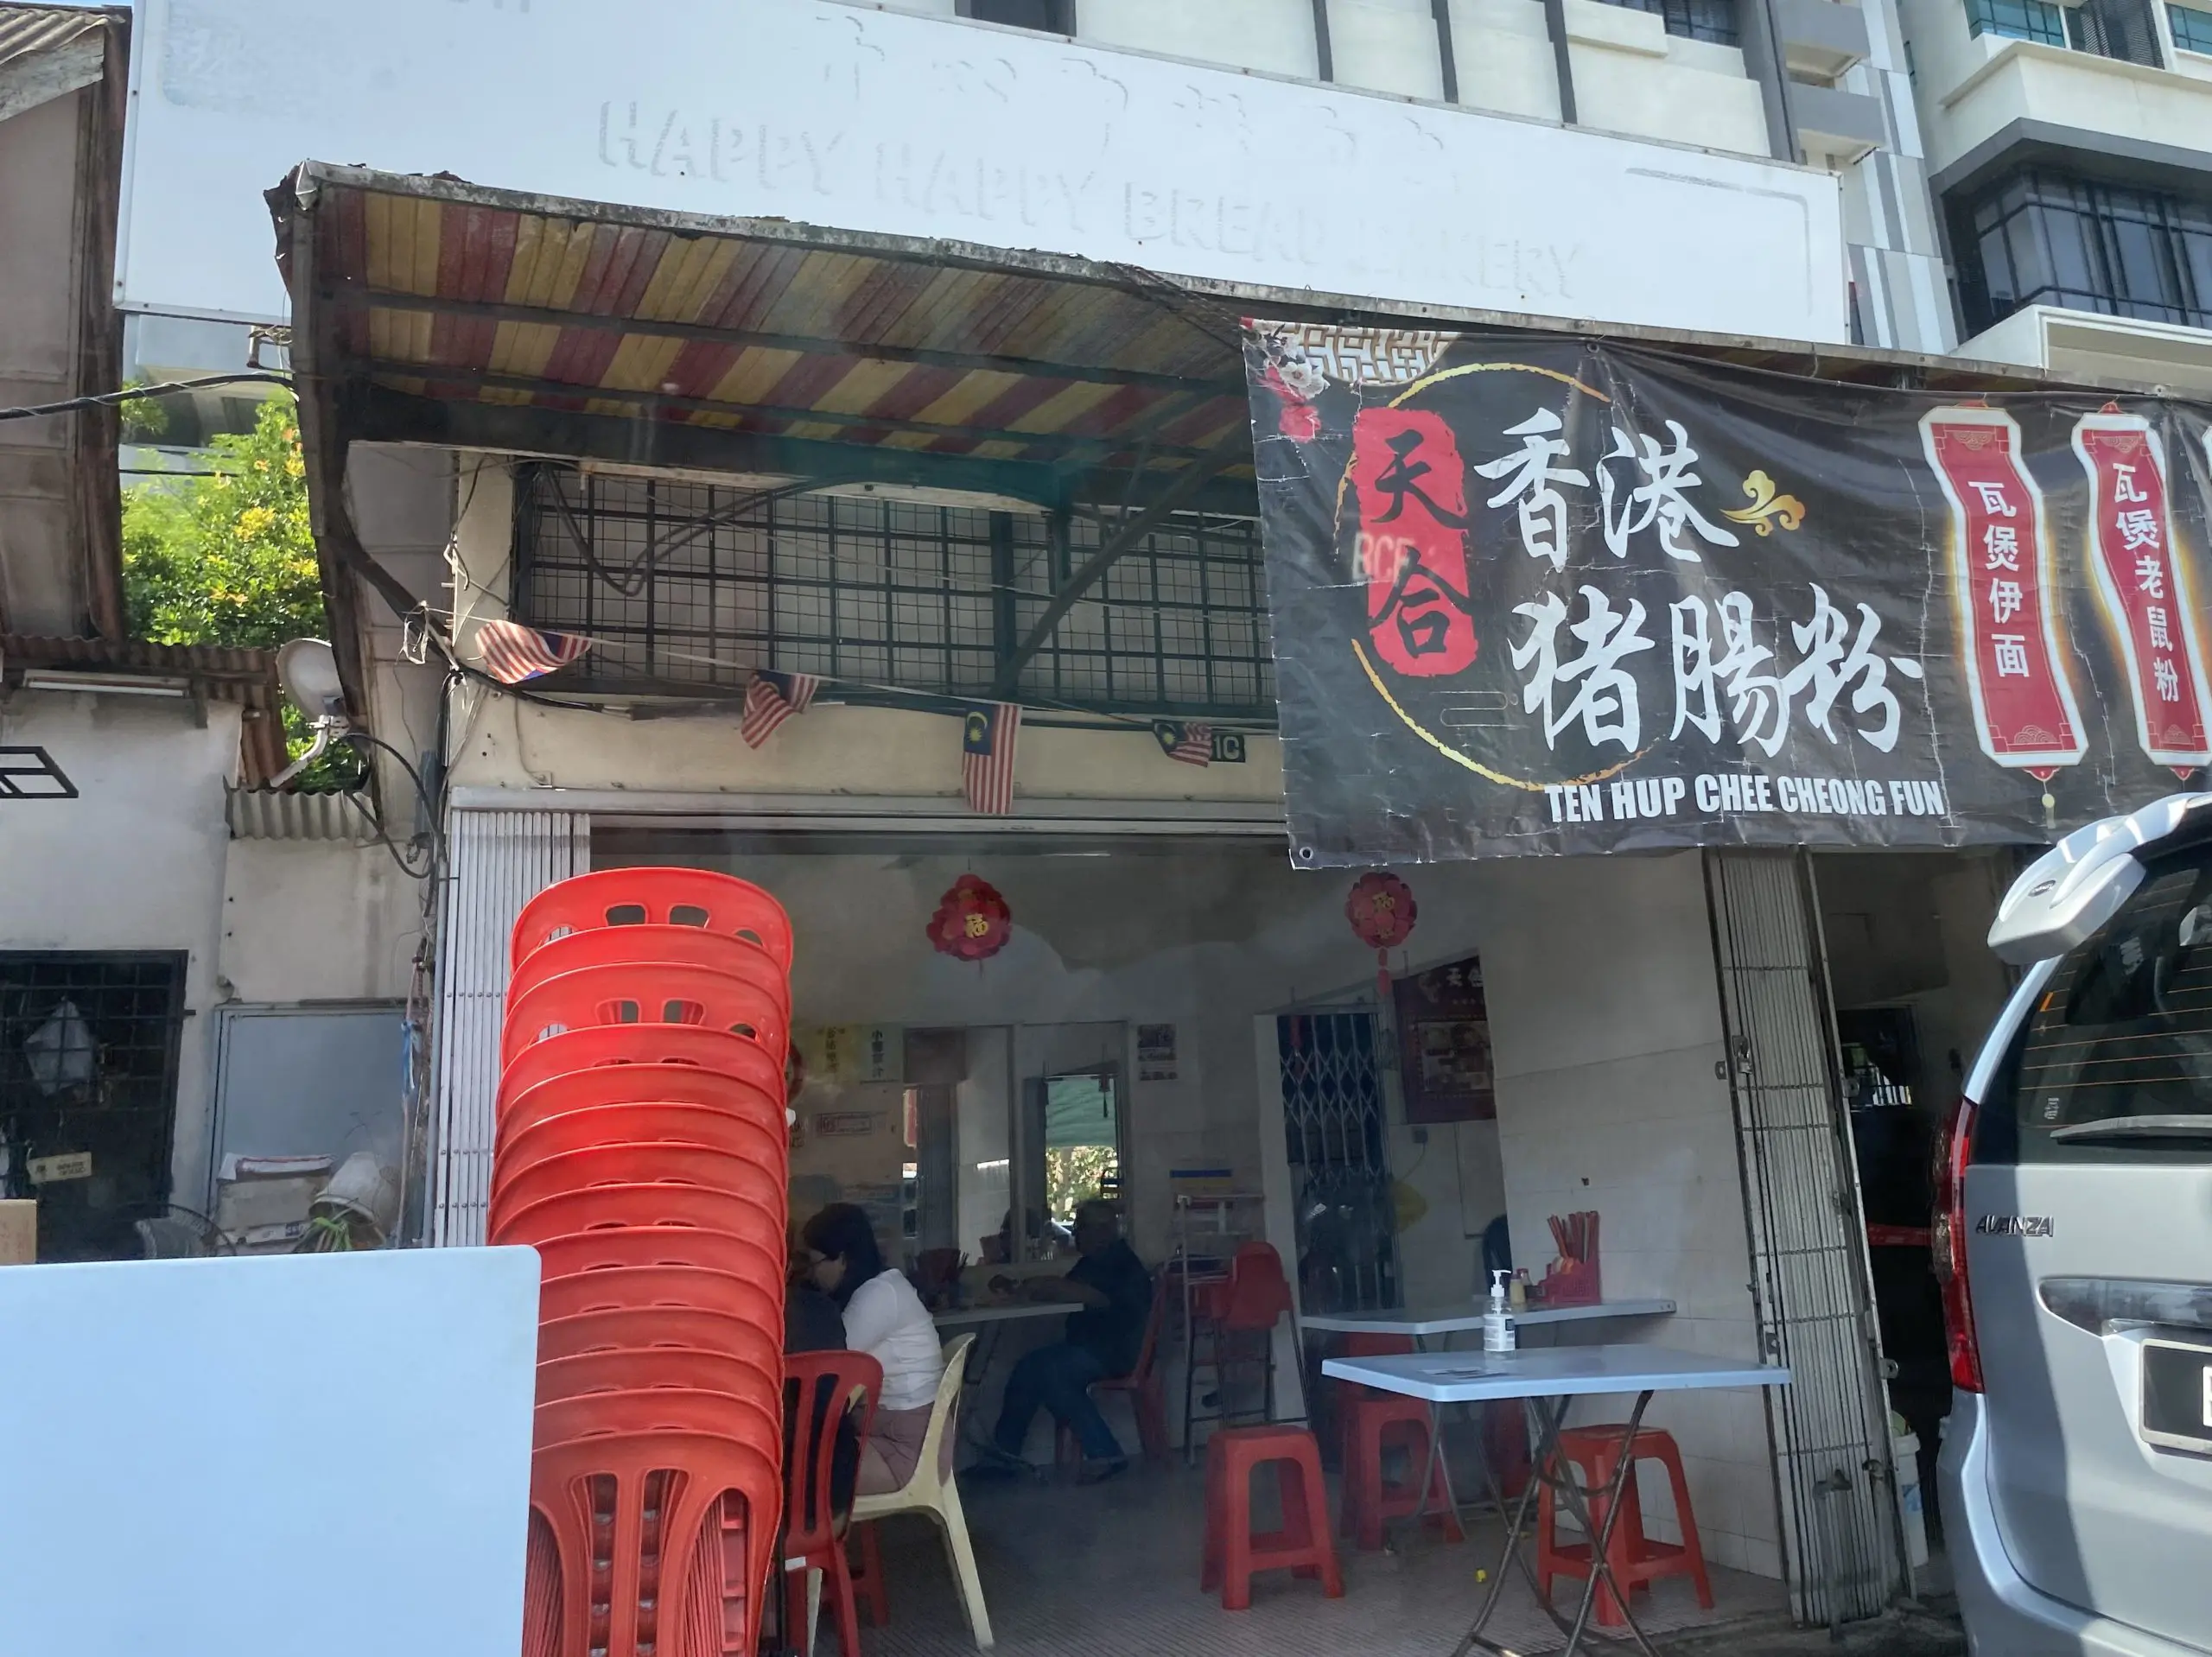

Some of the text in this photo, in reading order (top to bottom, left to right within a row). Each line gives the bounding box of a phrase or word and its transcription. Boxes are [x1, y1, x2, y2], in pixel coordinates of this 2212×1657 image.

[598, 98, 846, 196] HAPPY
[1370, 429, 1470, 660] 天合
[1474, 407, 1738, 573] 香港
[1967, 480, 2031, 678] 瓦煲伊面
[2111, 462, 2180, 702] 瓦煲老鼠粉
[1506, 581, 1923, 758] 猪腸粉
[1544, 773, 1946, 823] TEN HUP CHEE CHEONG FUN
[1975, 1214, 2054, 1237] AVANZA
